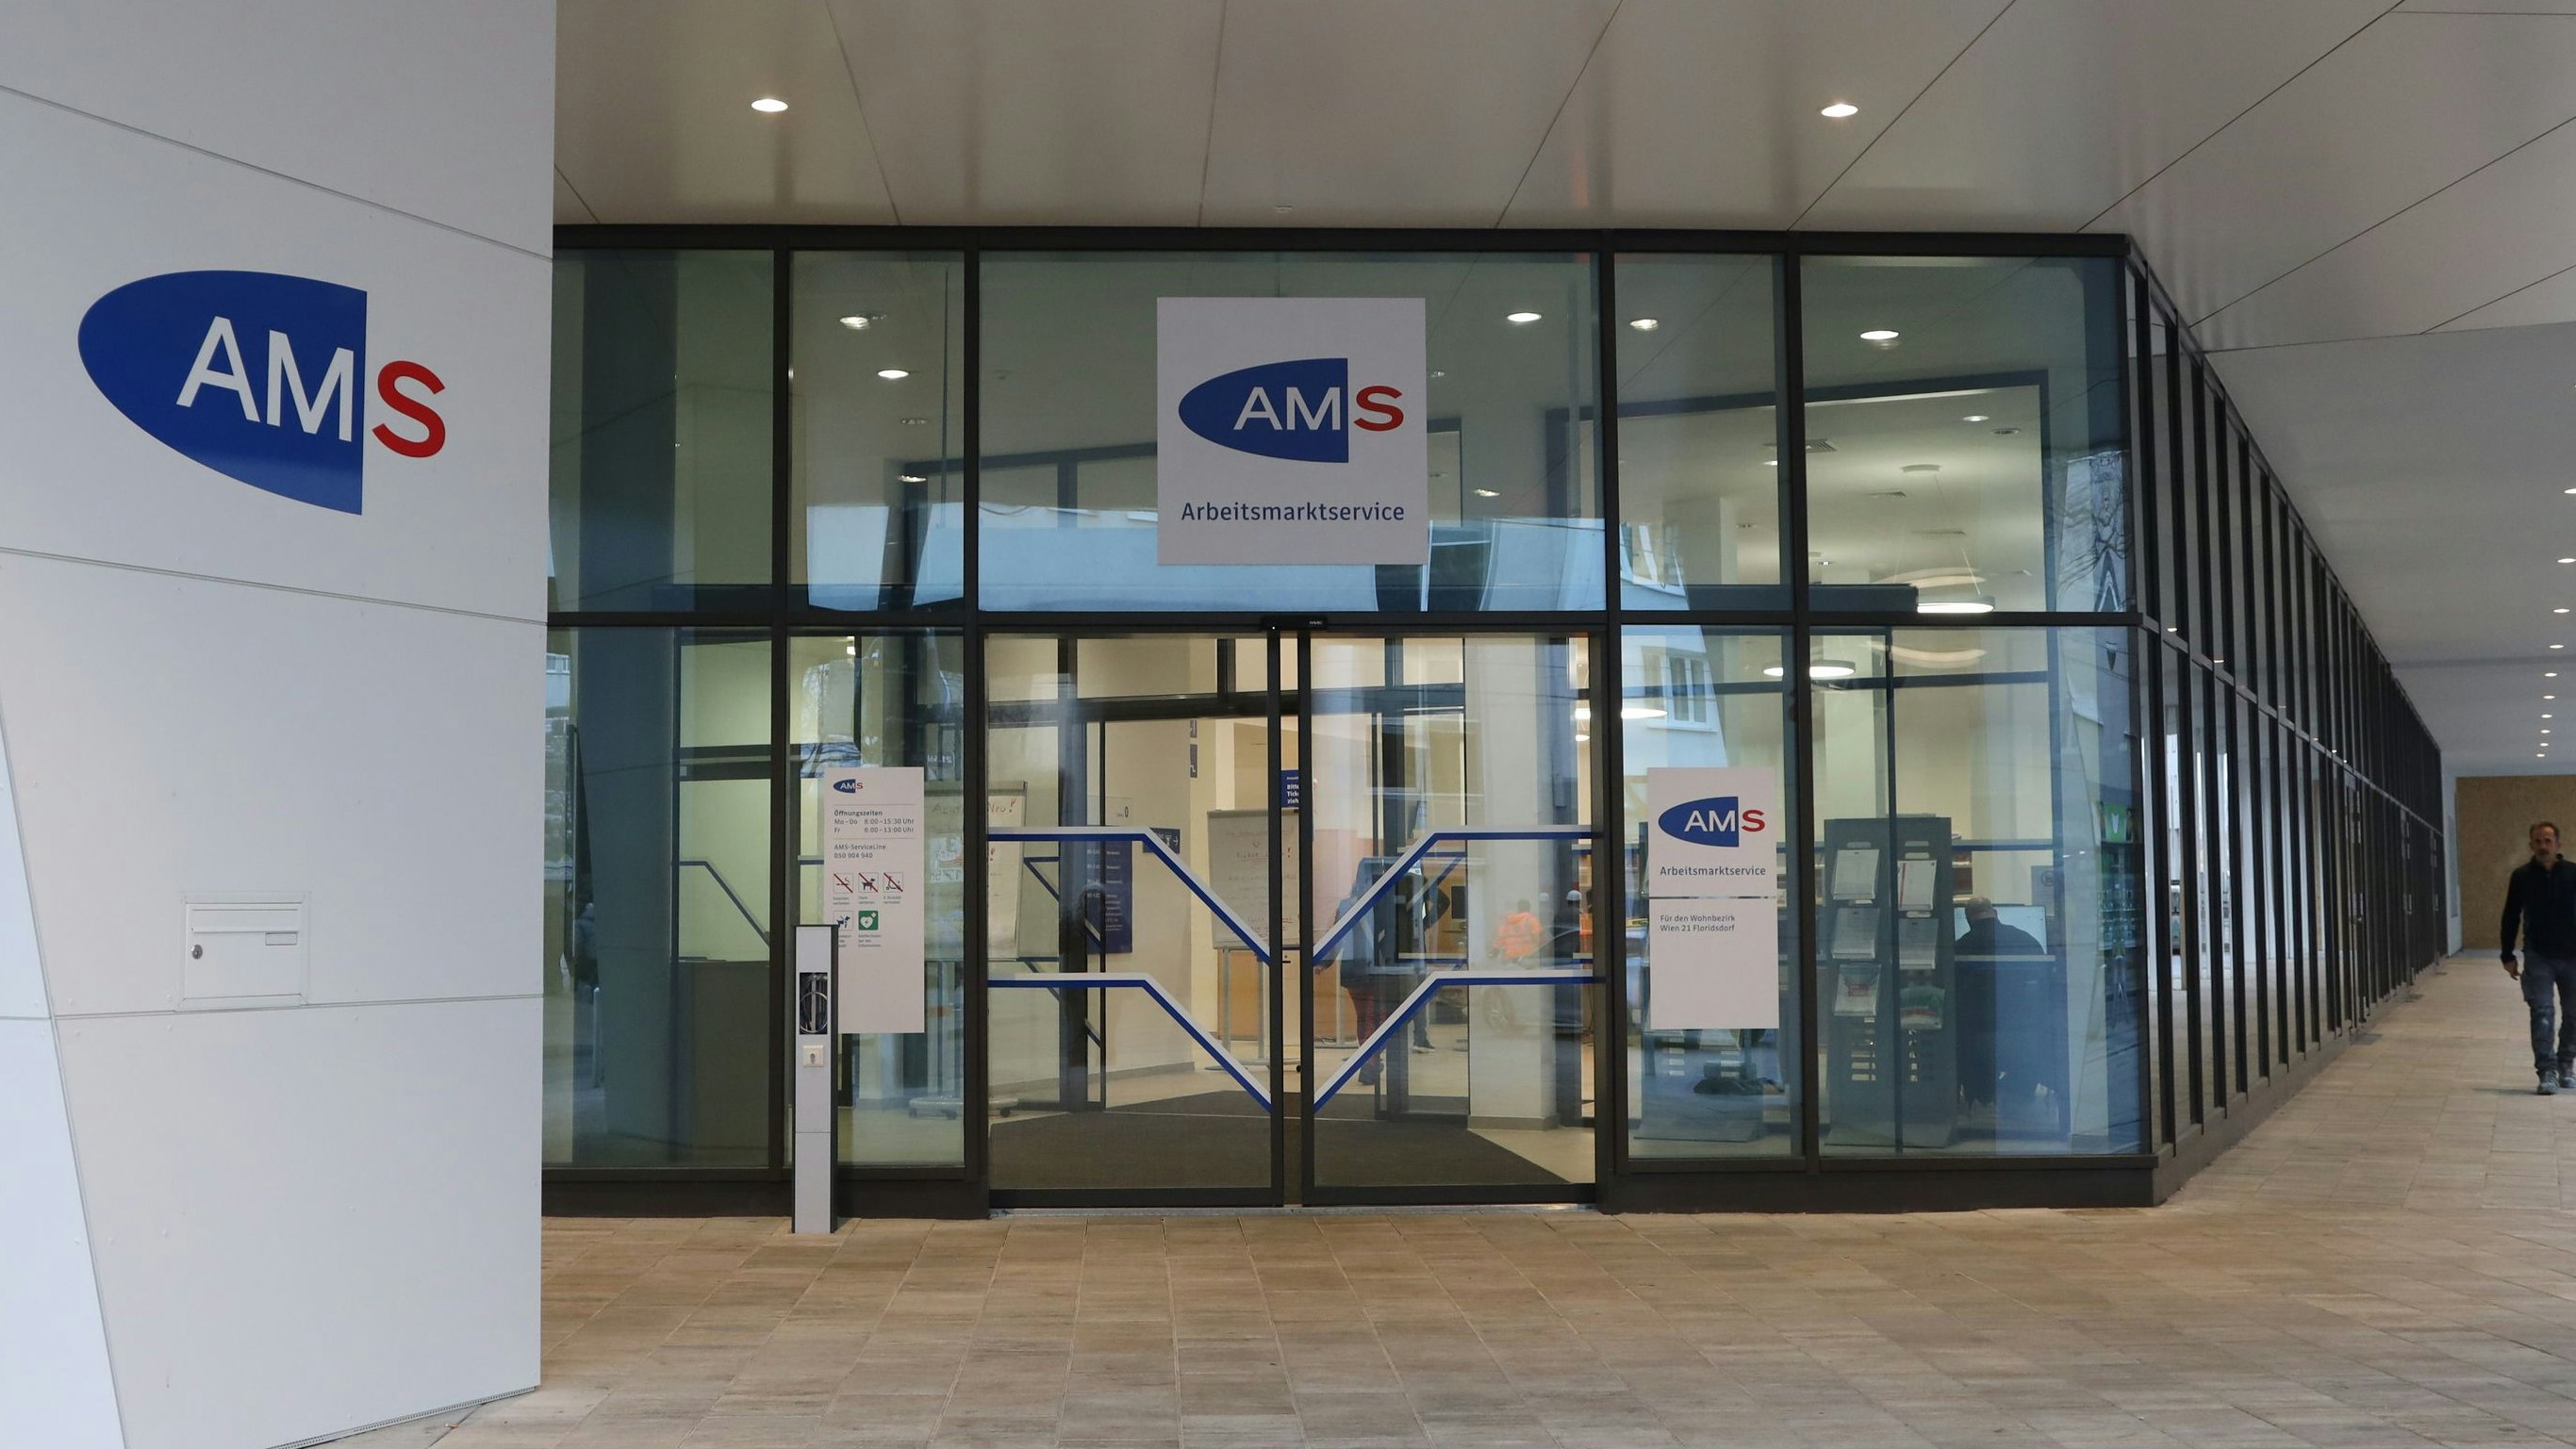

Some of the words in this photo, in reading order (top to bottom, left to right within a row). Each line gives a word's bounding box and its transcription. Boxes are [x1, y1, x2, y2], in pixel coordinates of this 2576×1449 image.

[176, 315, 446, 458] AMS
[1233, 385, 1405, 432] AMS
[1181, 502, 1405, 521] Arbeitsmarktservice
[839, 782, 864, 790] AMS
[834, 809, 883, 817] Öffnungszeiten
[1683, 809, 1766, 832] AMS
[1660, 865, 1766, 877] Arbeitsmarktservice
